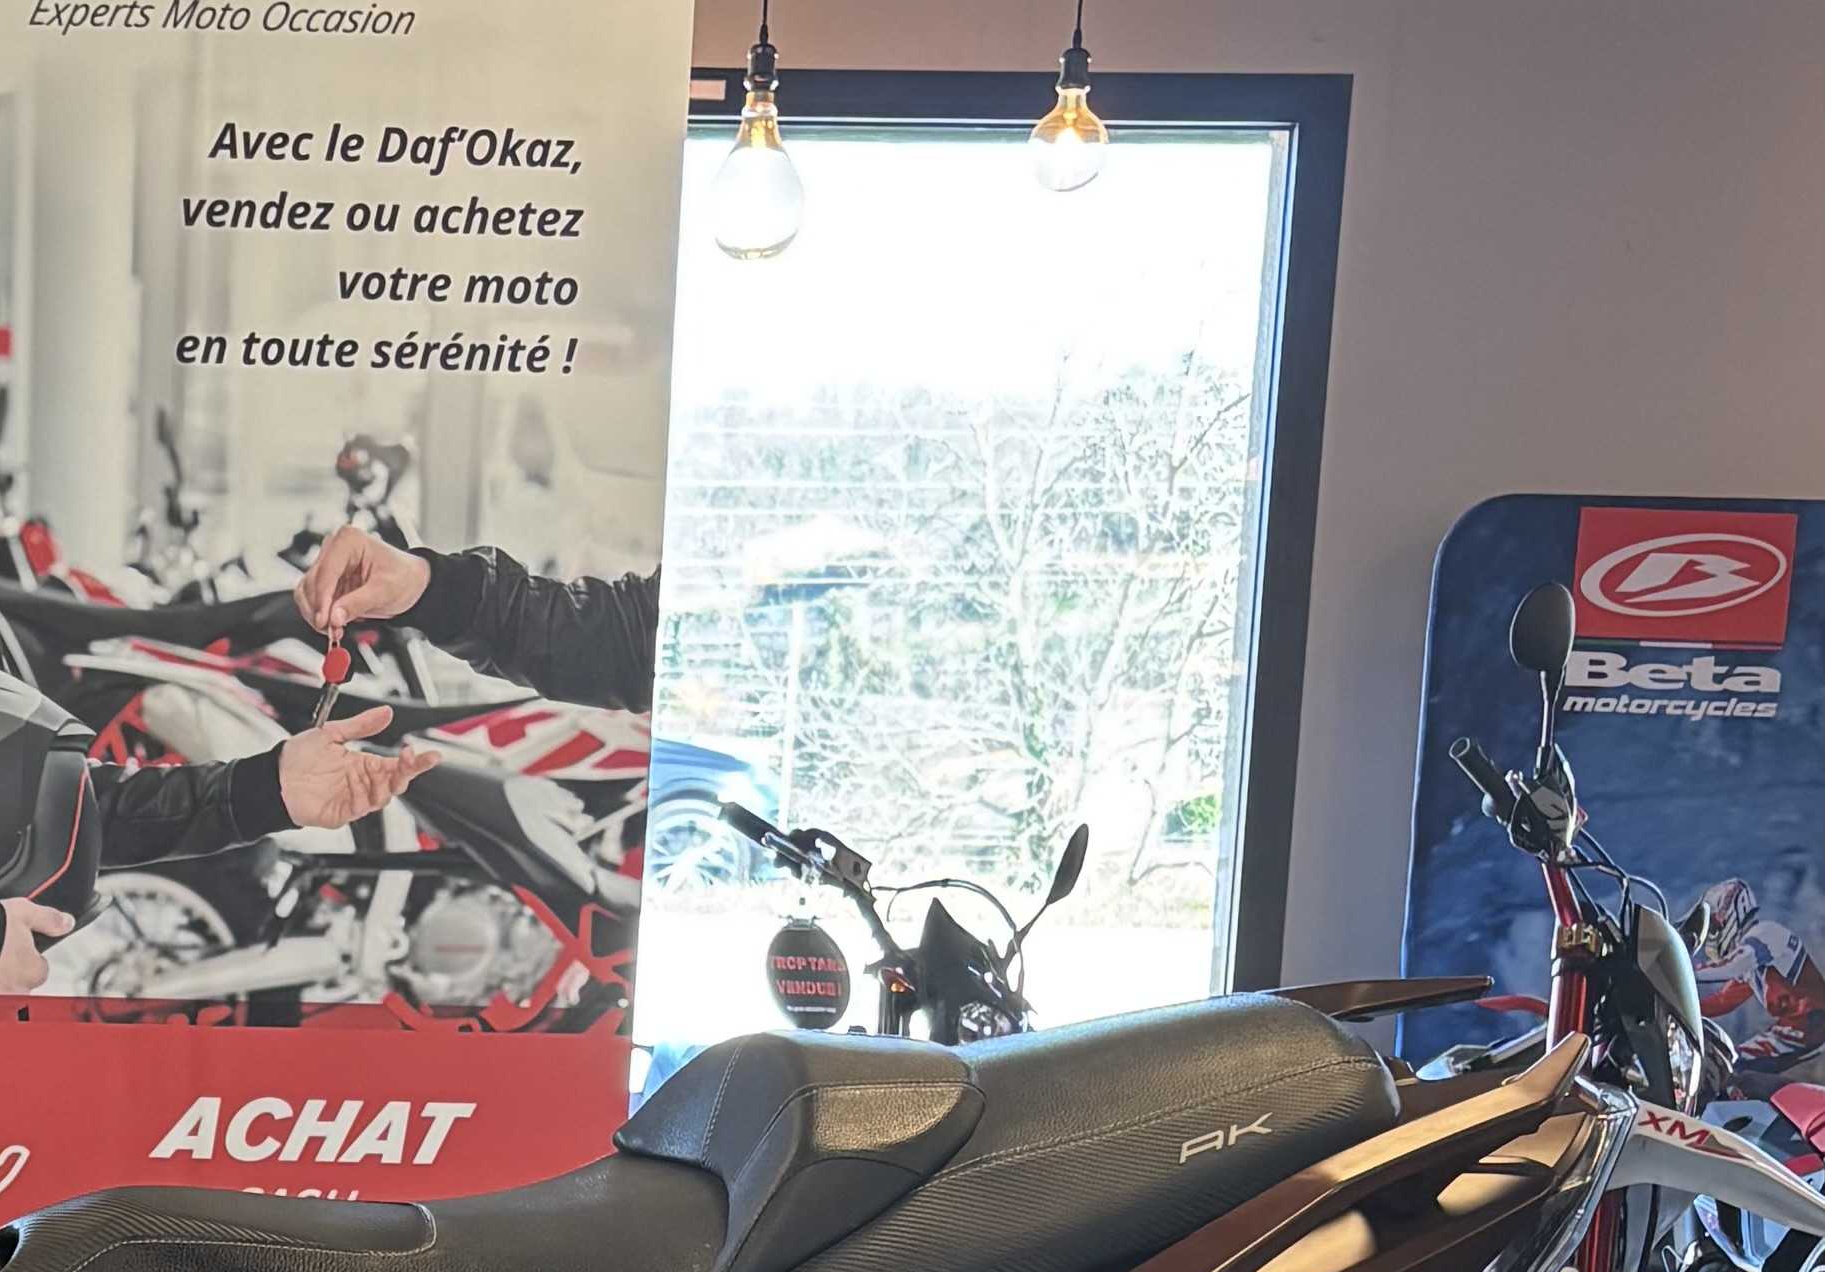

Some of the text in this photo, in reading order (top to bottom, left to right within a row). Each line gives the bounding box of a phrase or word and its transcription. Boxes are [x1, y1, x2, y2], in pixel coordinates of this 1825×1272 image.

[30, 0, 415, 36] Experts Moto Occasion
[208, 122, 314, 162] Avec
[325, 123, 365, 163] le
[183, 191, 584, 237] vendez ou achetez
[339, 267, 578, 306] votre moto
[176, 335, 227, 364] en
[243, 332, 359, 368] toute
[371, 331, 550, 373] sérénité
[1562, 650, 1782, 694] Beta
[1562, 694, 1779, 721] motorcycles
[148, 1096, 477, 1165] ACHAT
[1178, 1111, 1274, 1166] AK
